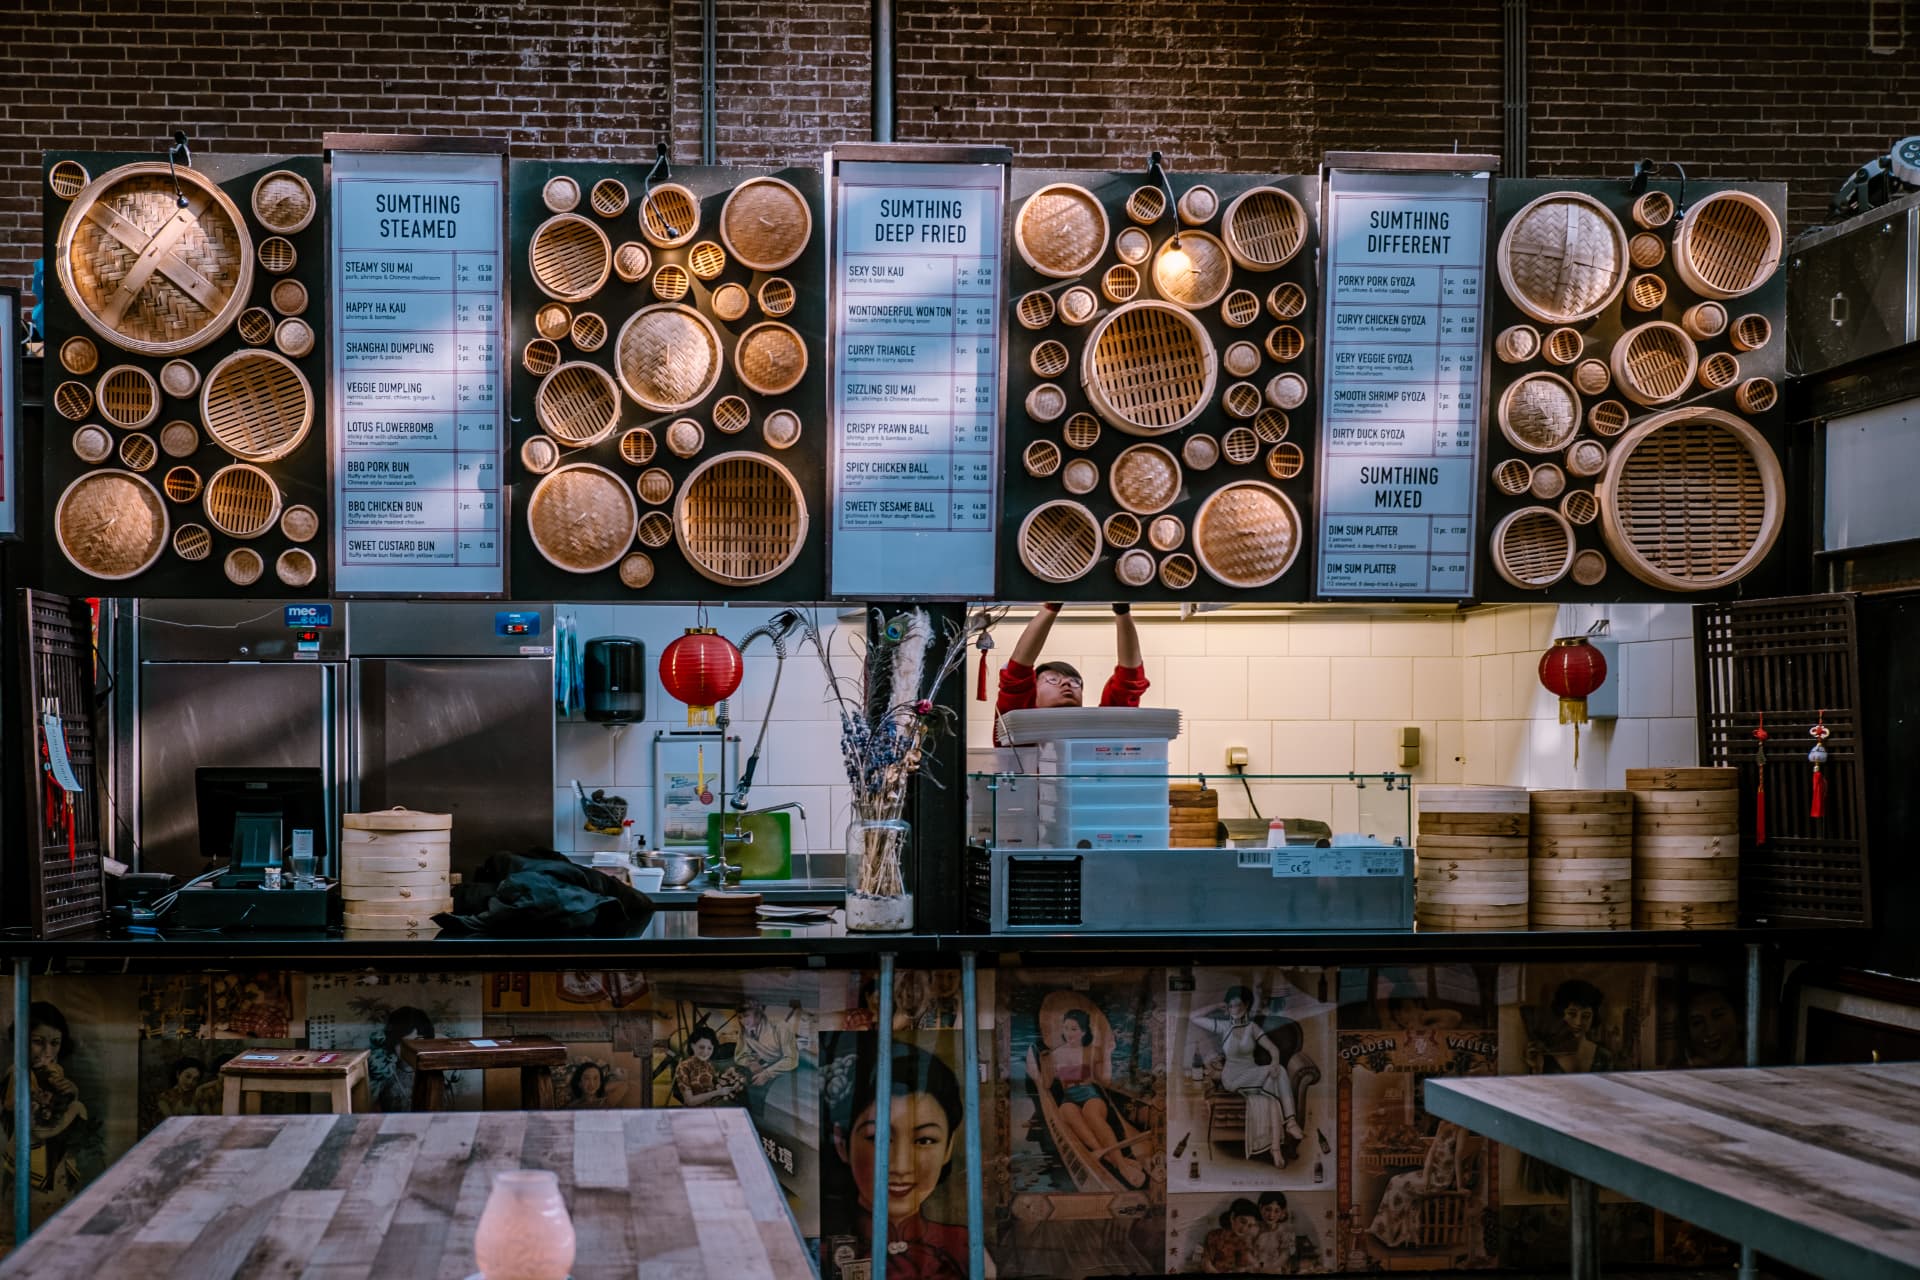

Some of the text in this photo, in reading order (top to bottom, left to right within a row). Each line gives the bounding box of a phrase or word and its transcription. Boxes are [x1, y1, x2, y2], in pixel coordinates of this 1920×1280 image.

[376, 194, 460, 214] SUMTHING
[880, 200, 962, 219] SUMTHING
[1370, 211, 1449, 230] SUMTHING
[380, 219, 456, 238] STEAMED
[875, 224, 966, 243] DEEP FRIED
[1368, 235, 1451, 254] DIFFERENT
[346, 262, 412, 273] STEAMY SIU MAI
[849, 266, 904, 276] SEXY SUI KAU
[1338, 276, 1415, 286] PORKY PORK GYOZA
[346, 302, 406, 313] HAPPY HA KAU
[849, 306, 913, 316] WONTONDERFUL
[1337, 314, 1426, 325] CURVY CHICKEN GYOZA
[346, 342, 434, 354] SHANGHAI DUMPLING
[848, 345, 916, 356] CURRY TRIANGLE
[1336, 352, 1412, 364] VERY VEGGIE GYOZA
[347, 382, 422, 393] VEGGIE DUMPLING
[848, 384, 916, 395] SIZZLING SIU MAI
[1334, 391, 1426, 401] SMOOTH SHRIMP GYOZA
[348, 422, 434, 432] LOTUS FLOWERBOMB
[846, 423, 929, 434] CRISPY PRAWN BALL
[1333, 428, 1405, 439] DIRTY DUCK GYOZA
[348, 462, 409, 472] BBQ PORK BUN
[846, 462, 928, 473] SPICY CHICKEN BALL
[1360, 467, 1438, 485] SUMTHING
[1375, 490, 1422, 508] MIXED
[348, 501, 422, 511] BBQ CHICKEN BUN
[846, 501, 934, 512] SWEETY SESAME BALL
[1329, 526, 1398, 536] DIM SUM PLATTER
[349, 541, 434, 551] SWEET CUSTARD BUN
[1328, 564, 1396, 573] DIM SUM PLATTER
[289, 608, 316, 616] mec
[1341, 1039, 1497, 1059] GOLDEN VALLEY
